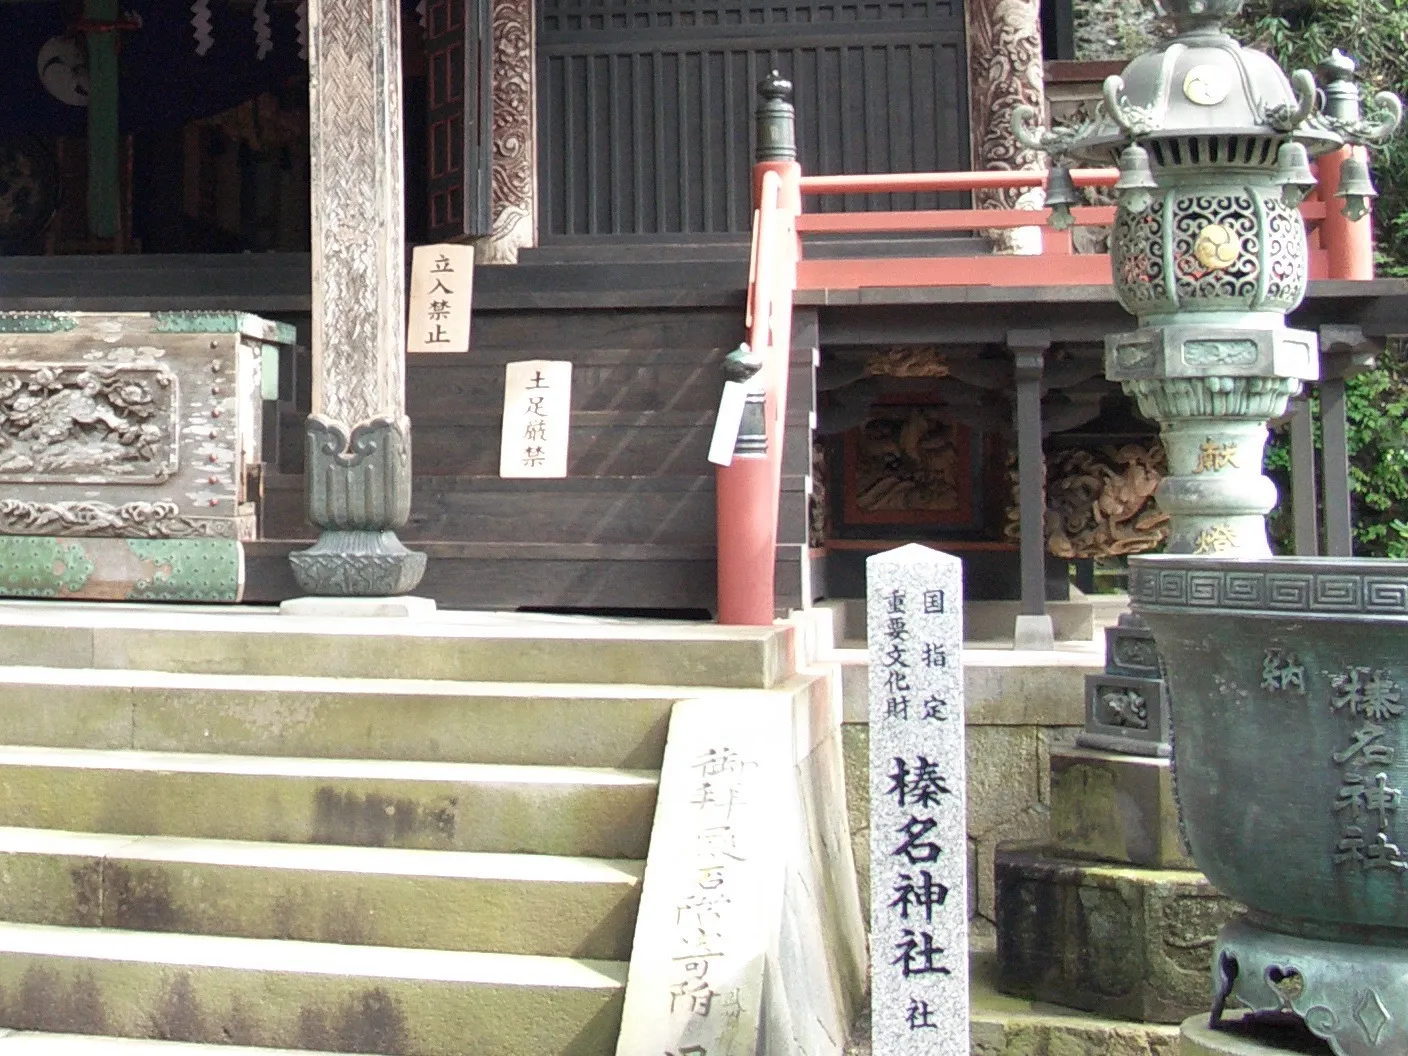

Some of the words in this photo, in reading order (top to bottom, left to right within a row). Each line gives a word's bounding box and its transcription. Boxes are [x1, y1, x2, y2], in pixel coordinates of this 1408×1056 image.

[424, 253, 455, 344] 立入禁止
[522, 371, 550, 467] 土足厳禁
[884, 589, 910, 721] 重要文化財
[923, 589, 948, 721] 国指定
[1261, 647, 1306, 694] 納
[1330, 665, 1408, 869] 榛名神社
[886, 755, 952, 978] 榛名神社
[905, 997, 938, 1031] 社
